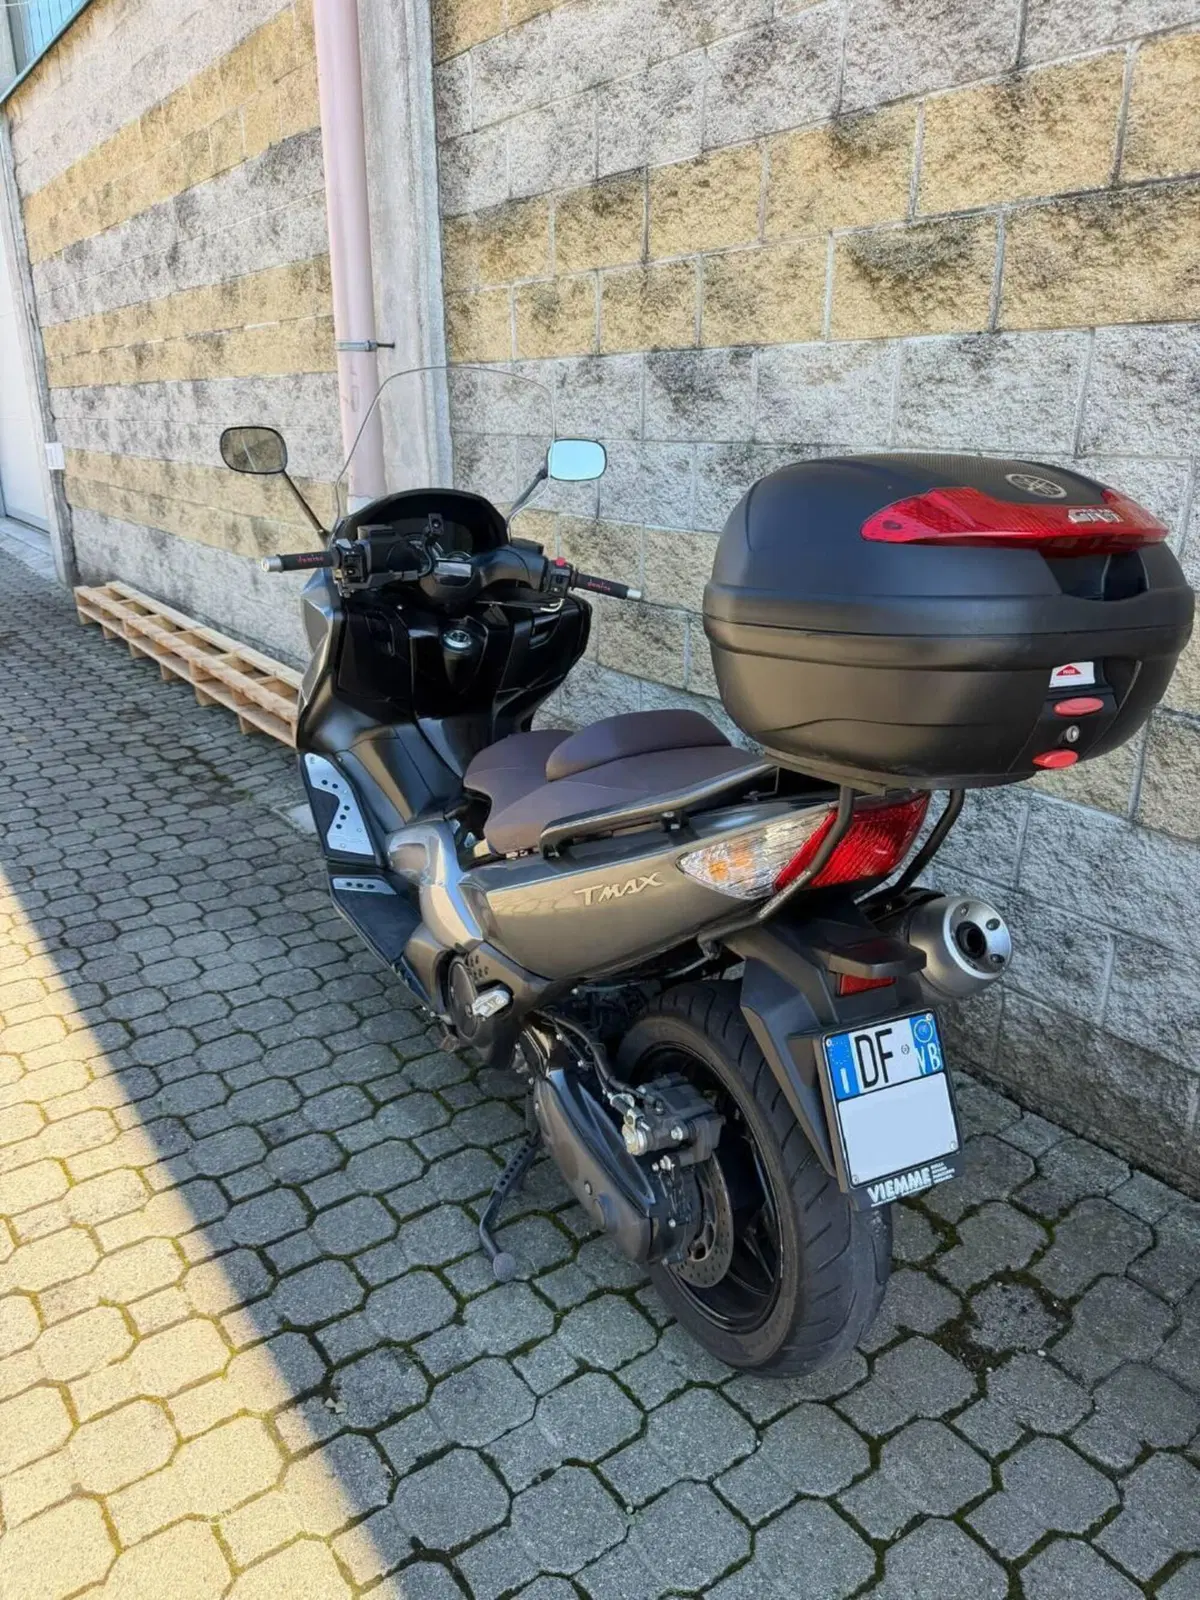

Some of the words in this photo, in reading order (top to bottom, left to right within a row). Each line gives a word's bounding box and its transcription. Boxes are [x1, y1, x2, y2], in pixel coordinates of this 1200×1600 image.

[854, 1028, 894, 1090] DF
[915, 1042, 941, 1075] VB
[867, 1167, 932, 1203] VIEMME
